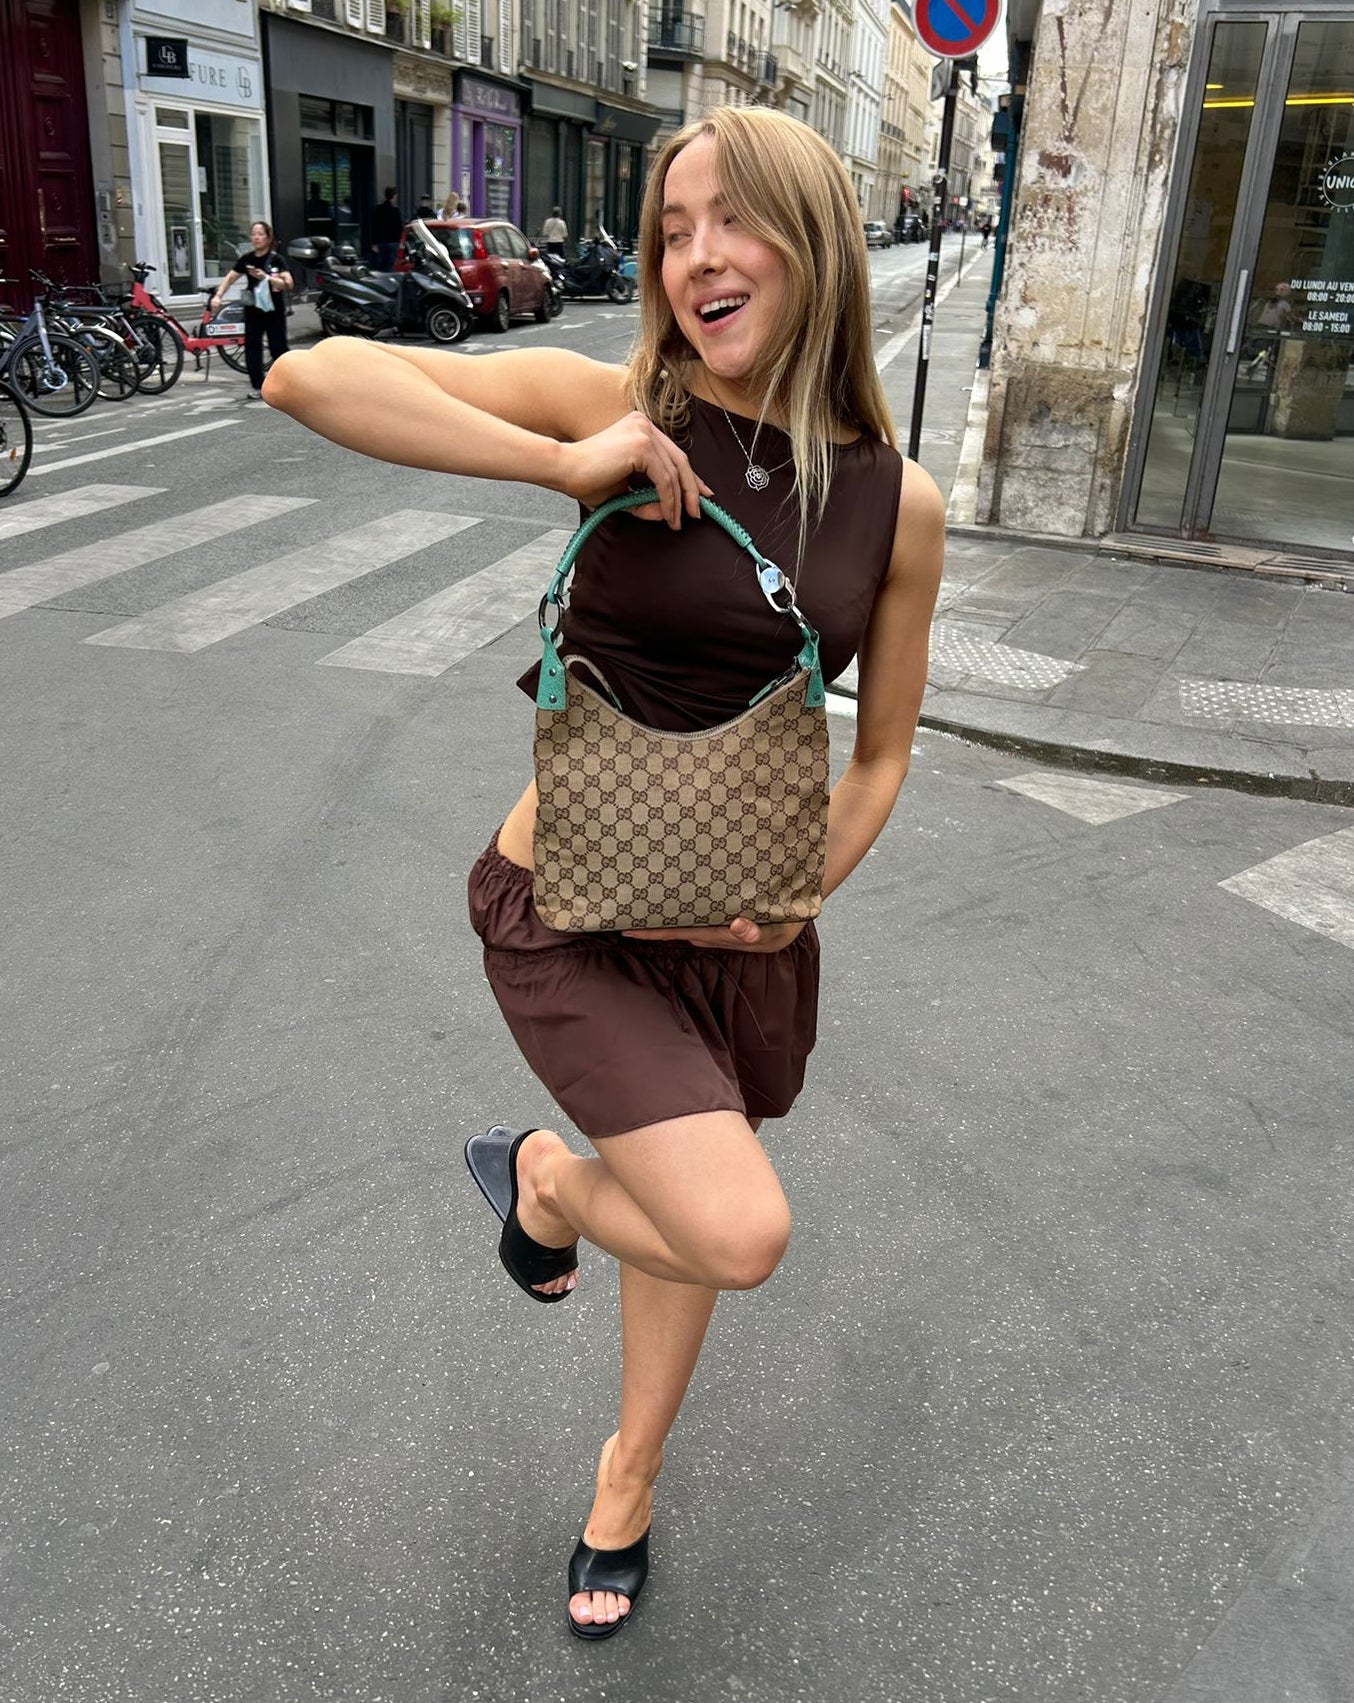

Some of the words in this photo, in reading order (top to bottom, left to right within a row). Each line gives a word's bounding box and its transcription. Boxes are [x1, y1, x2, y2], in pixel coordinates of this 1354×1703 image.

[1291, 279, 1303, 289] DU
[1303, 280, 1326, 290] LUNDI
[1326, 281, 1339, 291] AU
[1307, 291, 1329, 302] 08:00
[1308, 310, 1318, 321] LE
[1318, 311, 1349, 322] SAMEDI
[1330, 323, 1350, 334] 15:00
